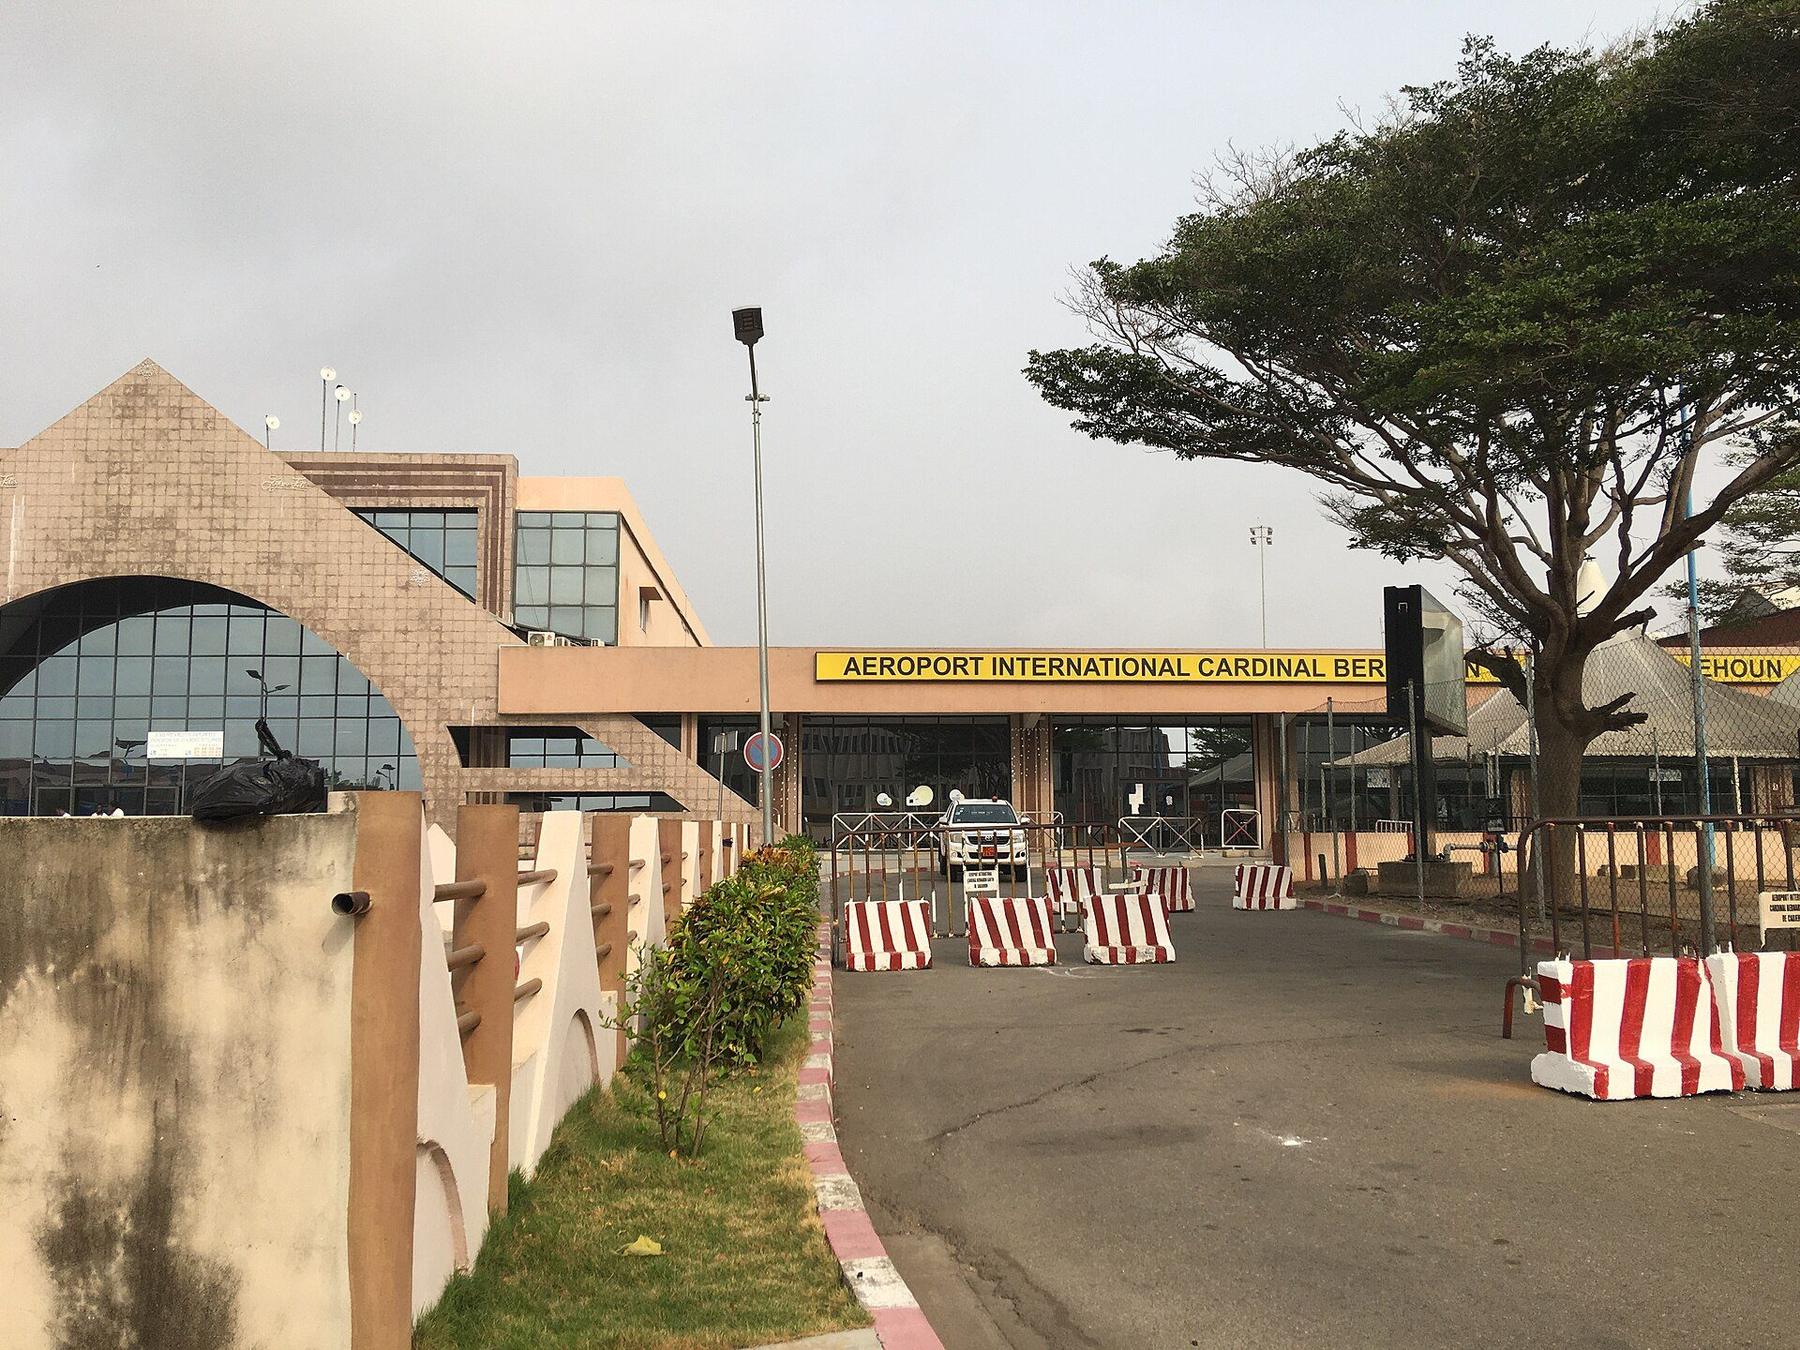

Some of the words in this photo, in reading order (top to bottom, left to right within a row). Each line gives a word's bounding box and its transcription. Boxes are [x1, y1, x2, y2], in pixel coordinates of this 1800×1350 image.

[843, 656, 983, 676] AEROPORT
[992, 657, 1190, 677] INTERNATIONAL
[1199, 657, 1326, 678] CARDINAL
[1700, 658, 1782, 678] EHOUN
